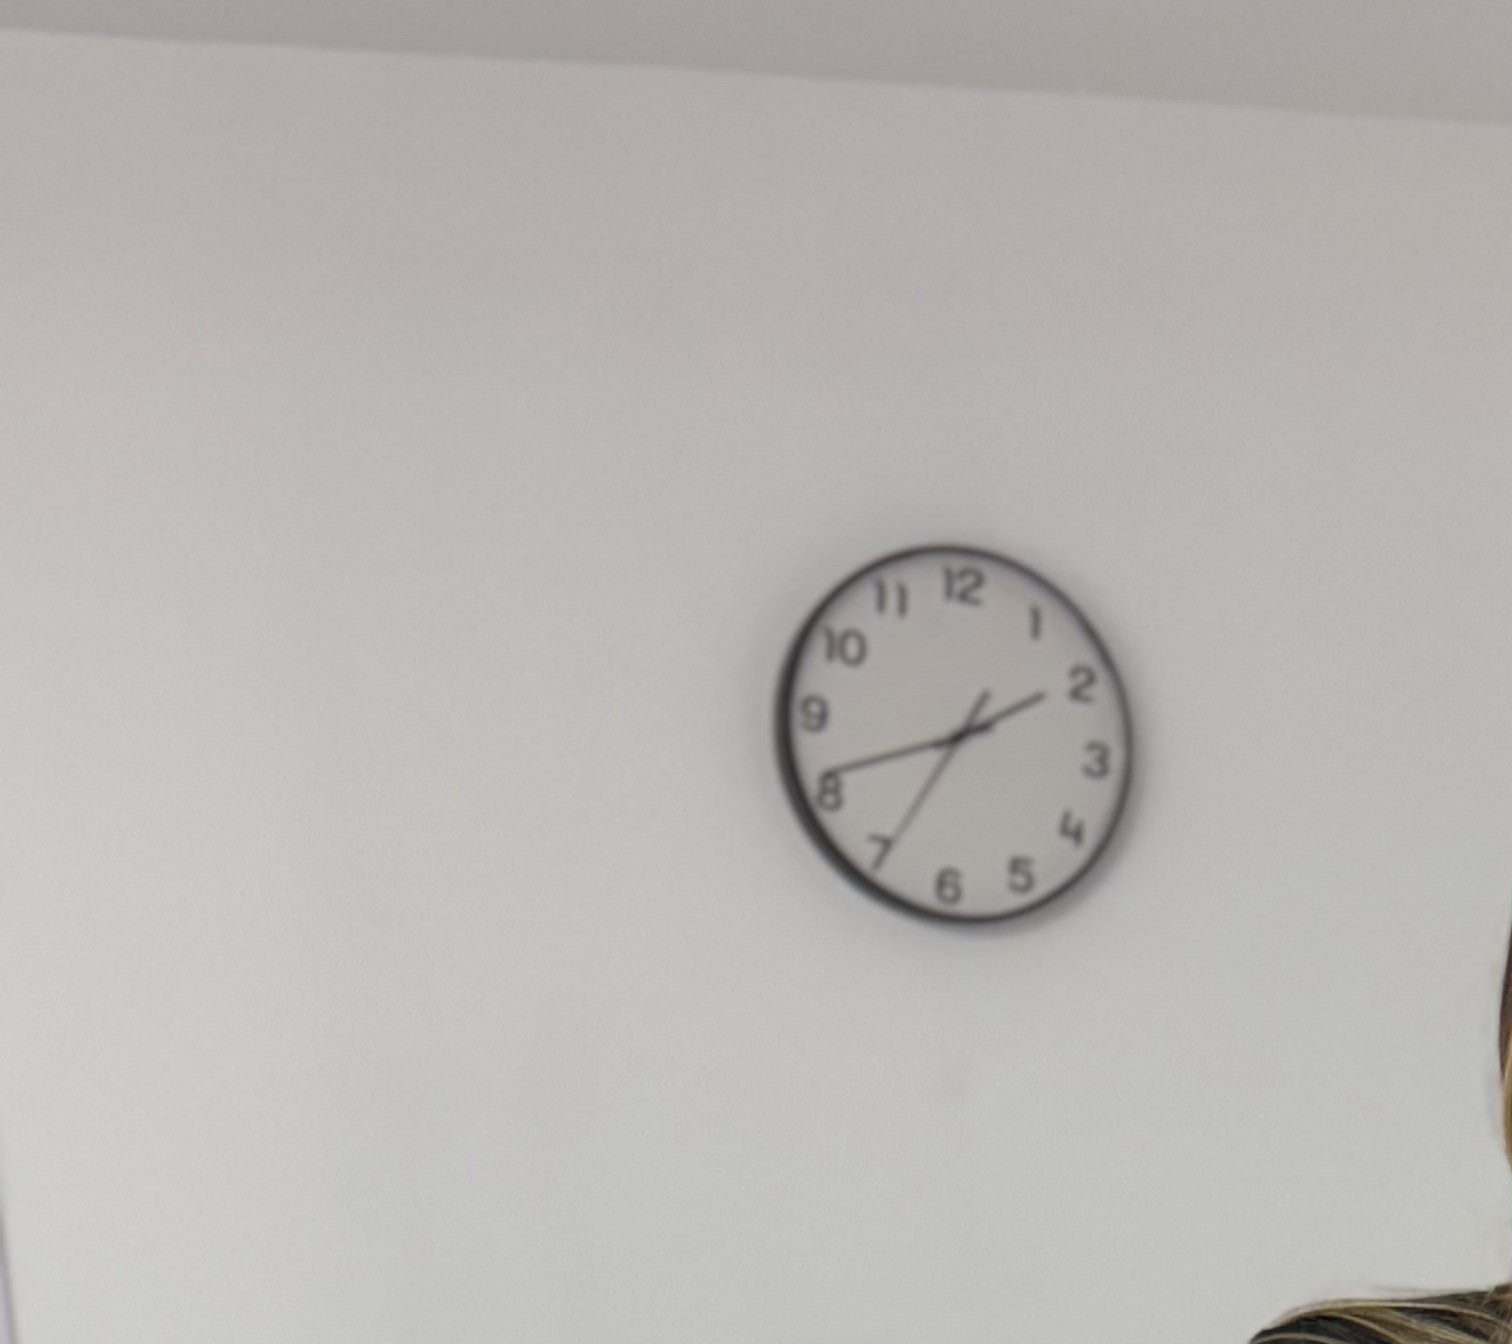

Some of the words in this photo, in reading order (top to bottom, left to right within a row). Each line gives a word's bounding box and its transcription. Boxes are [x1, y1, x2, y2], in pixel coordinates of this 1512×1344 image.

[874, 577, 908, 618] 11
[942, 566, 985, 606] 12
[1029, 604, 1041, 640] 1
[823, 626, 868, 667] 10
[1067, 664, 1097, 703] 2
[801, 695, 829, 733] 9
[1081, 740, 1111, 780] 3
[817, 769, 843, 811] 8
[1059, 808, 1085, 848] 4
[866, 834, 895, 872] 7
[934, 865, 963, 904] 6
[1007, 855, 1034, 895] 5
